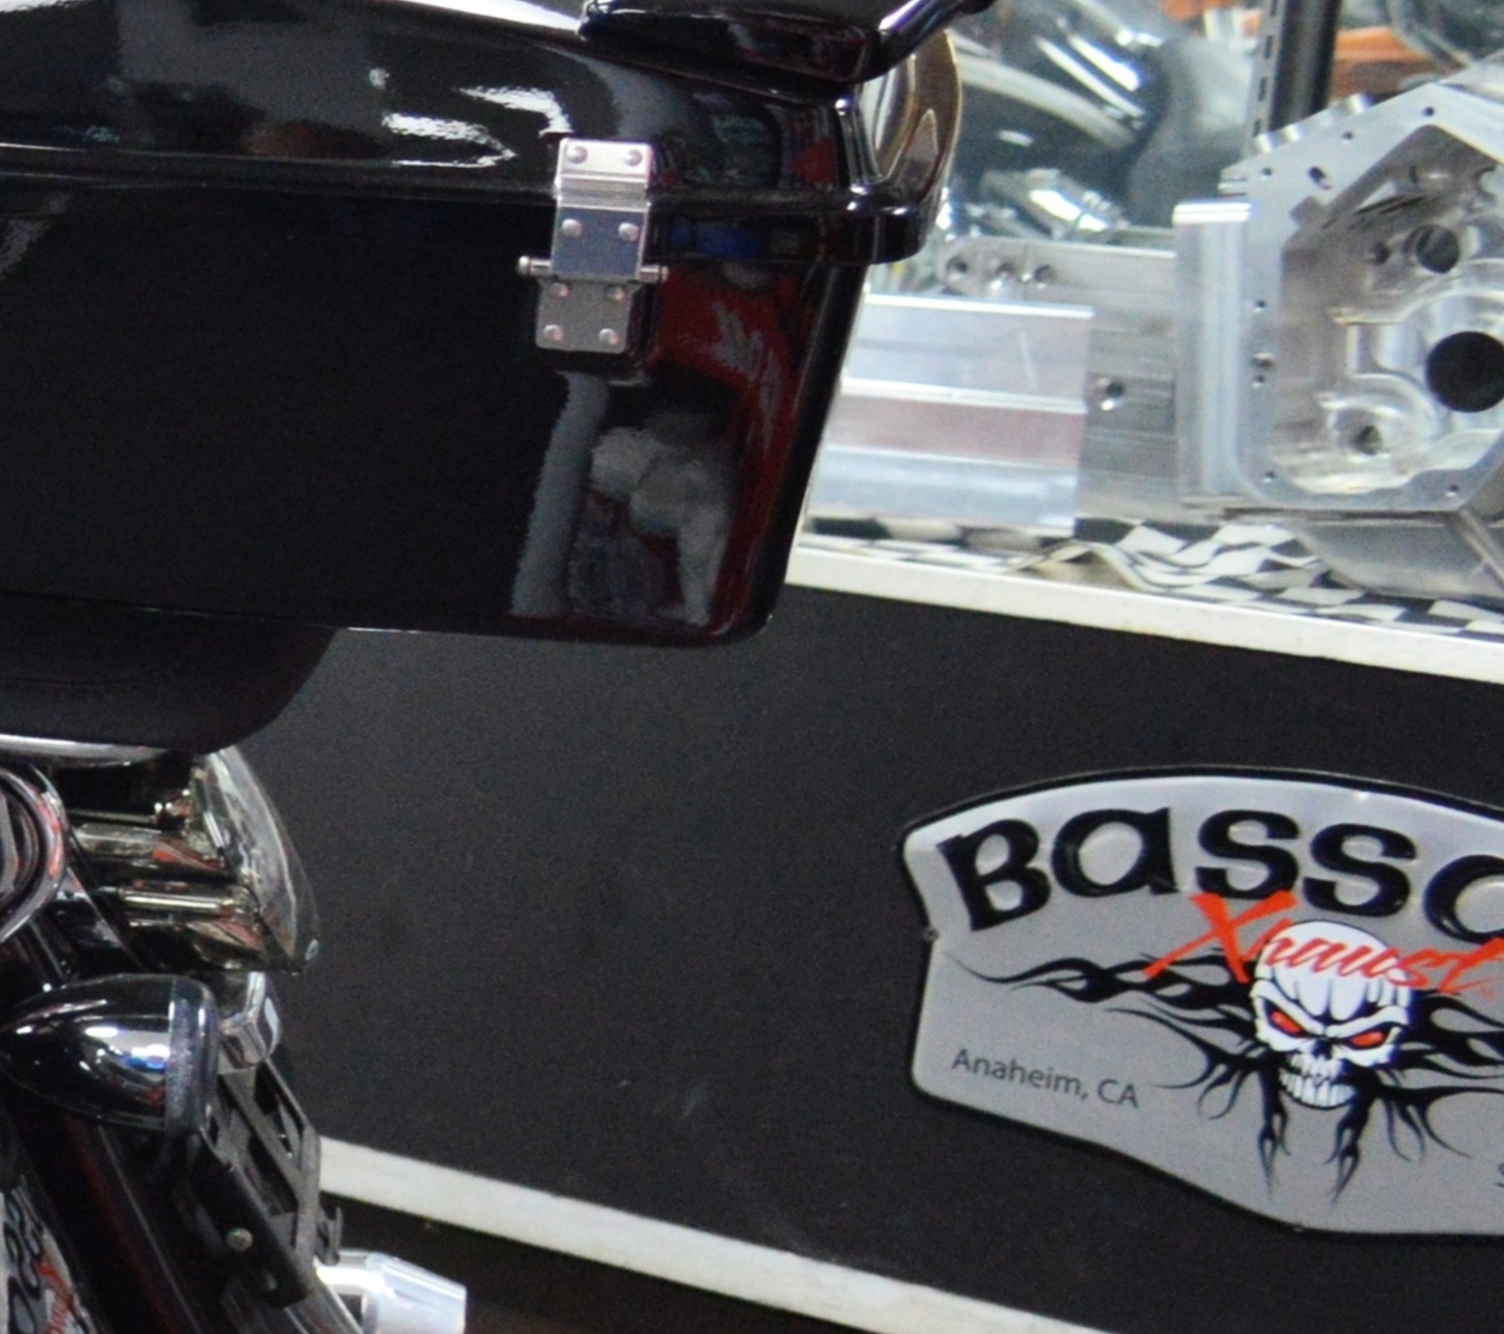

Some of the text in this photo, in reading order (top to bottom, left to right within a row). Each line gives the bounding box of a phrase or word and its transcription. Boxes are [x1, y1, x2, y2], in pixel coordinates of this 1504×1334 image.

[1144, 891, 1504, 996] Xhaust
[951, 1048, 1138, 1109] Anaheim, CA
